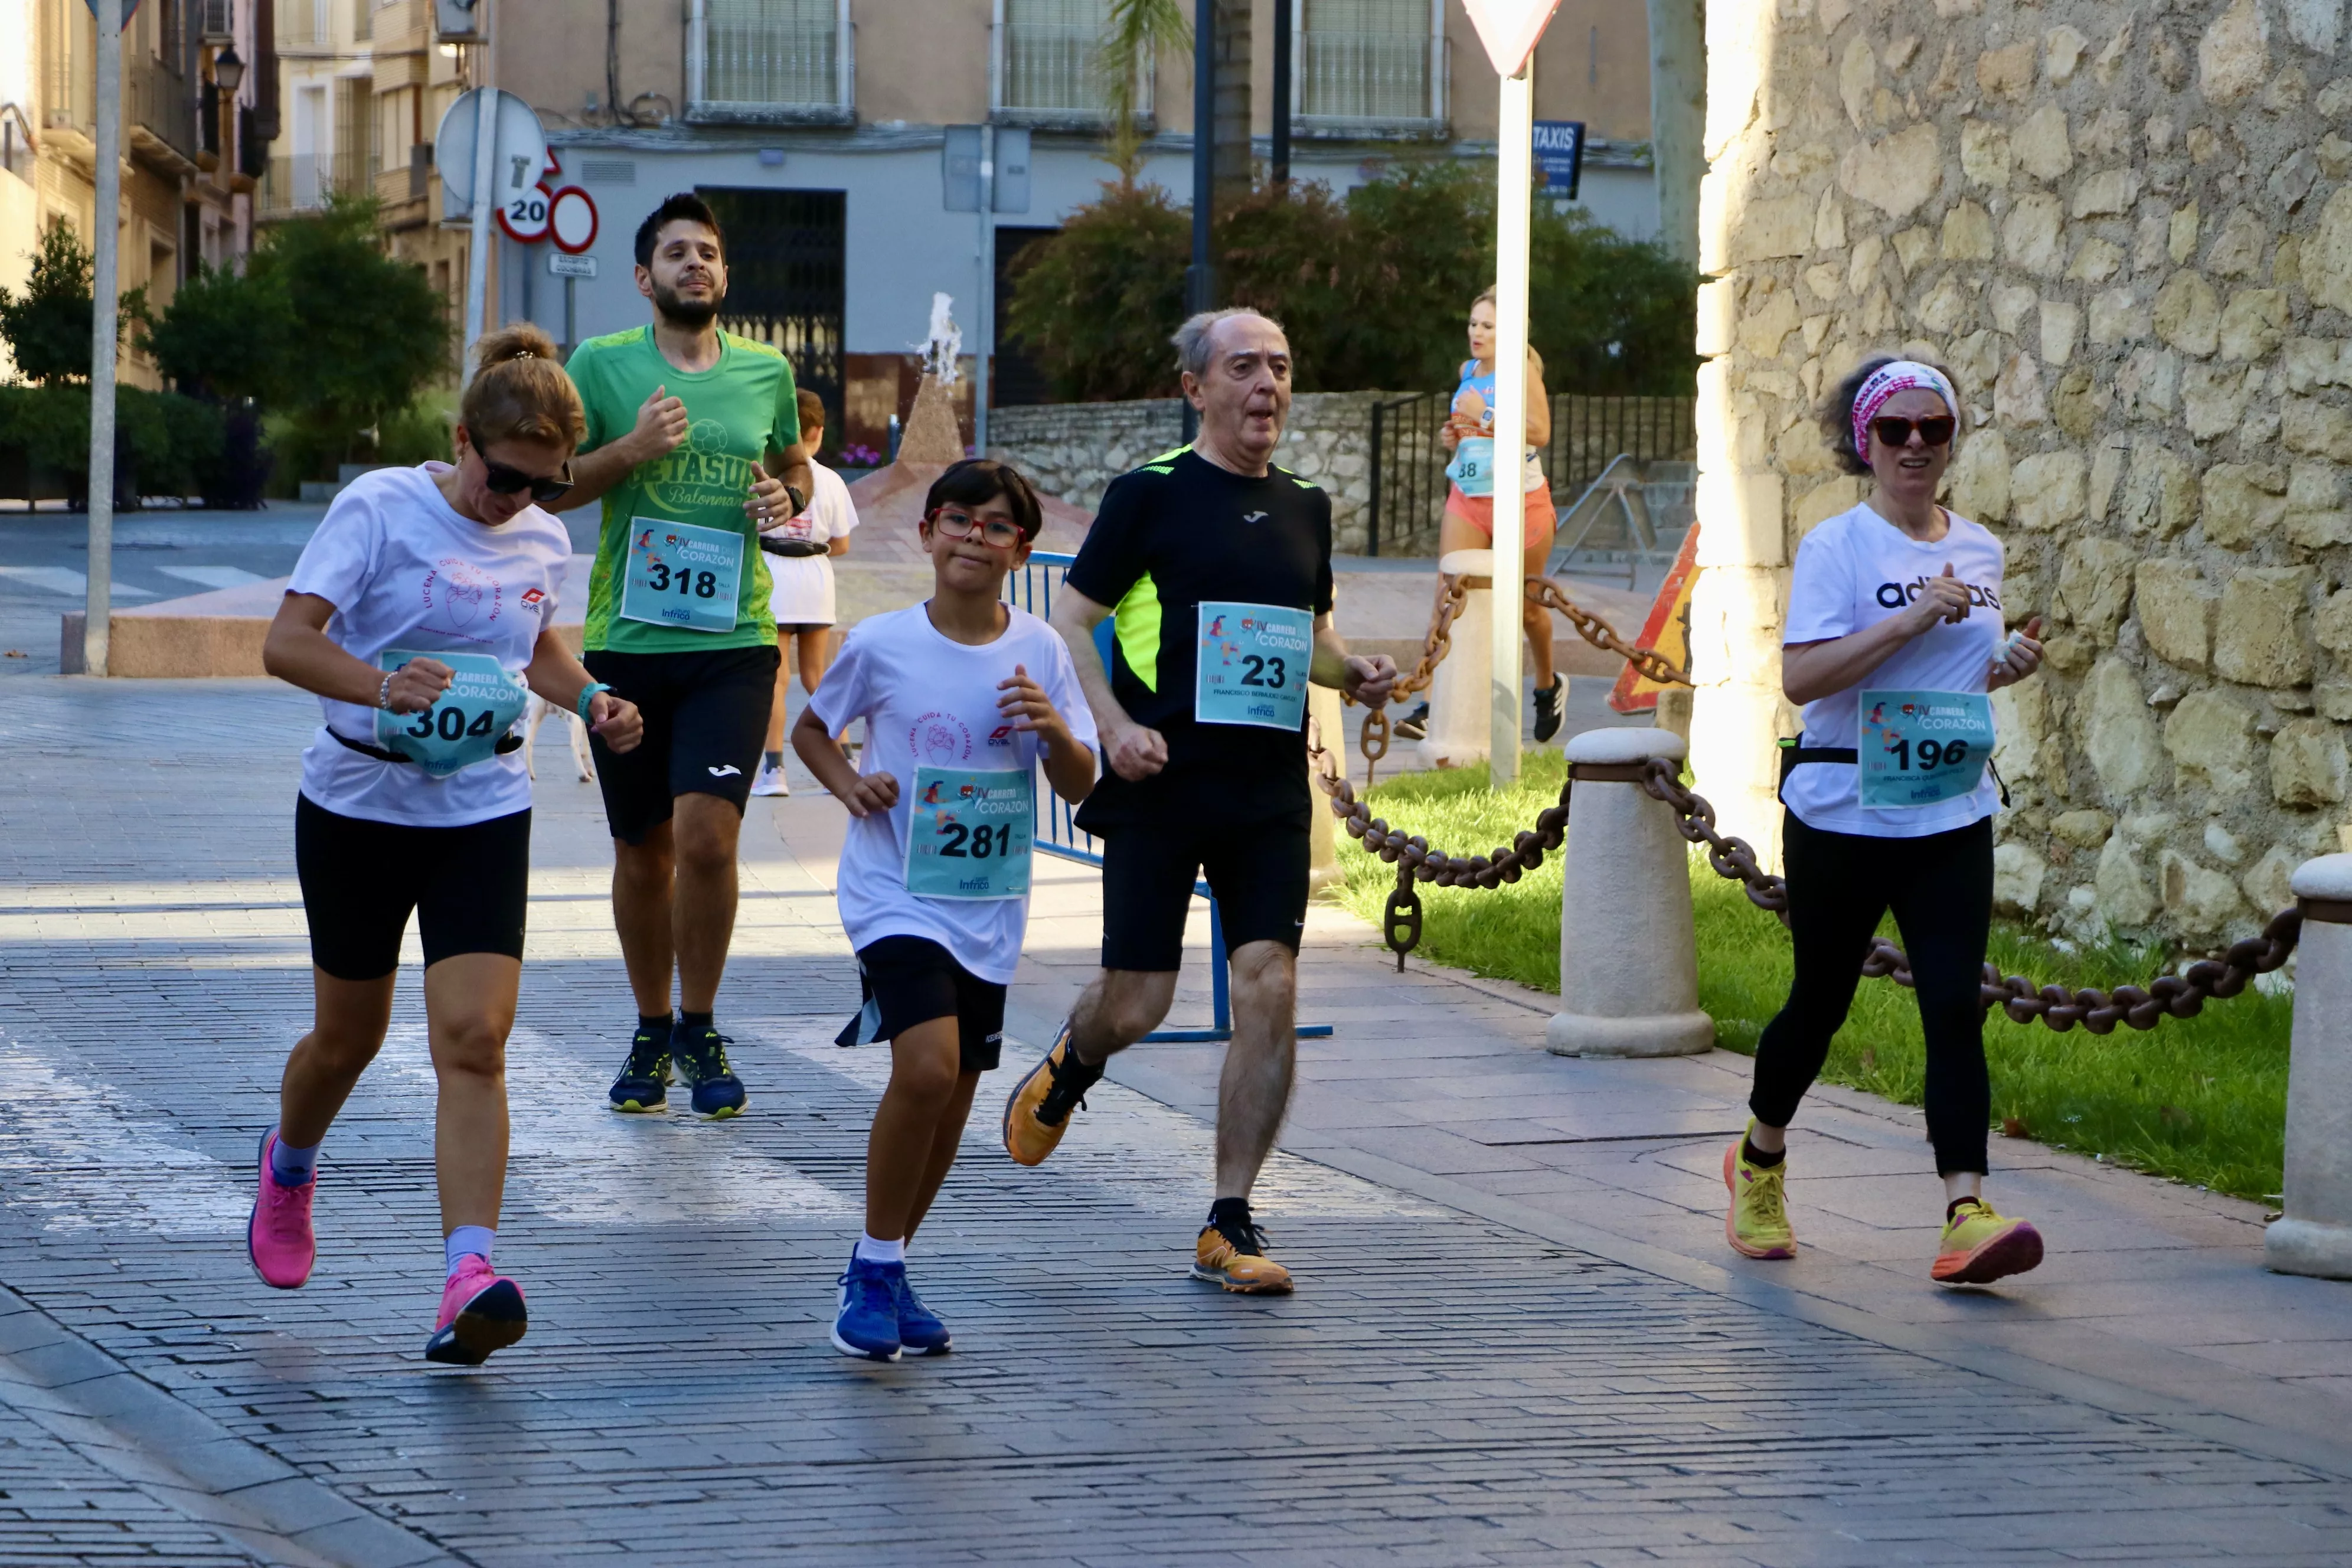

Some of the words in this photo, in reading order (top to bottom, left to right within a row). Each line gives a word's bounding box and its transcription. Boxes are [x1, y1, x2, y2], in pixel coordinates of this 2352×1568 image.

[1533, 126, 1574, 151] TAXIS
[511, 200, 545, 221] 20
[669, 485, 743, 506] Balonman
[688, 540, 719, 553] CARRERA
[423, 570, 437, 609] LUCENA
[649, 564, 716, 598] 318
[662, 609, 690, 620] Infrico
[1266, 623, 1296, 636] CARRERA
[456, 672, 498, 685] CARRERA
[1241, 655, 1285, 688] 23
[917, 711, 942, 723] CUIDA
[946, 713, 957, 721] TU
[1247, 705, 1275, 717] Infrico
[1929, 706, 1965, 716] CARRERA
[407, 707, 494, 741] 304
[1891, 739, 1969, 770] 196
[940, 823, 1011, 858] 281
